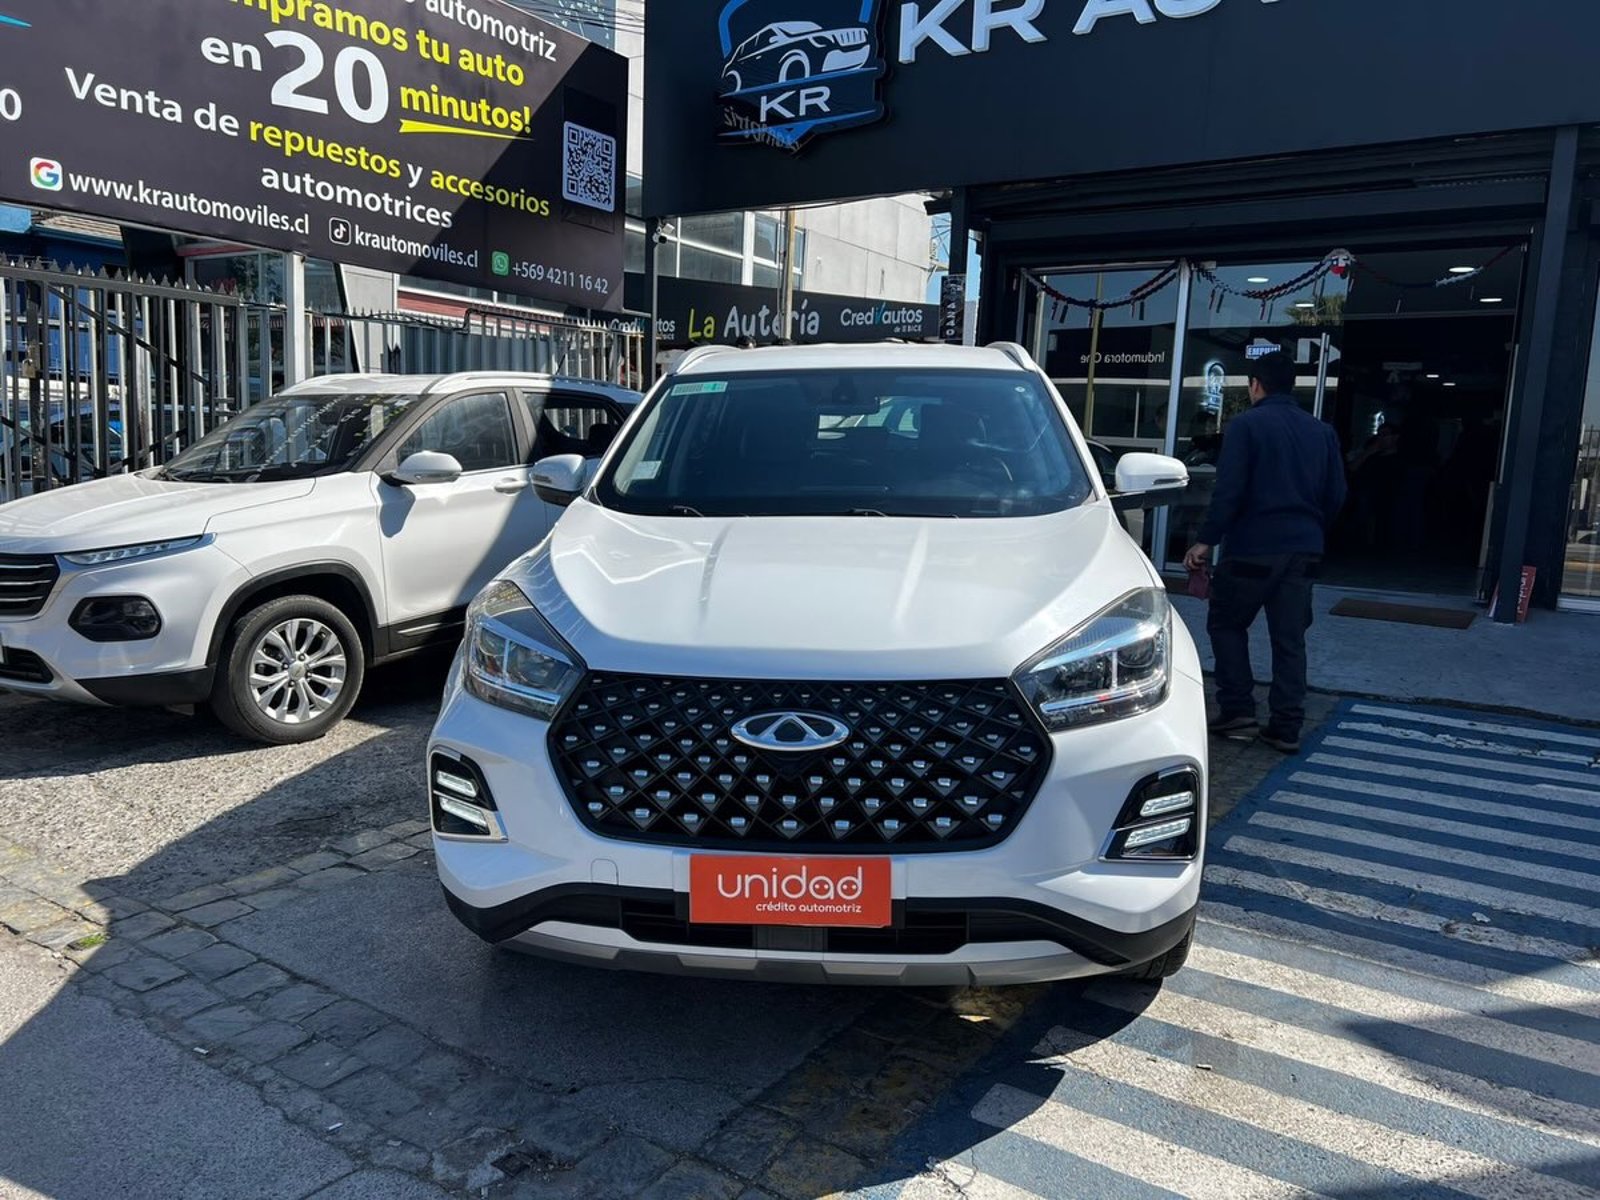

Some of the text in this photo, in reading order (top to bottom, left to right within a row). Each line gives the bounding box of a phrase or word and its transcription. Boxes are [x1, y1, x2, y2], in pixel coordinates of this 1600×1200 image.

[416, 29, 450, 65] tu
[458, 48, 525, 87] auto
[425, 0, 558, 62] automotriz
[898, 0, 1048, 64] KR
[200, 30, 532, 134] en 20 minutos!
[760, 86, 831, 122] KR
[65, 66, 550, 217] Venta de repuestos y accesorios
[69, 172, 310, 235] www.krautomoviles.cl
[261, 166, 453, 229] automotrices
[355, 225, 478, 268] krautomoviles.cl
[512, 258, 609, 295] +569 4211 16 42
[688, 308, 716, 339] La
[717, 864, 863, 900] unidad
[755, 901, 862, 914] crédito automotriz
